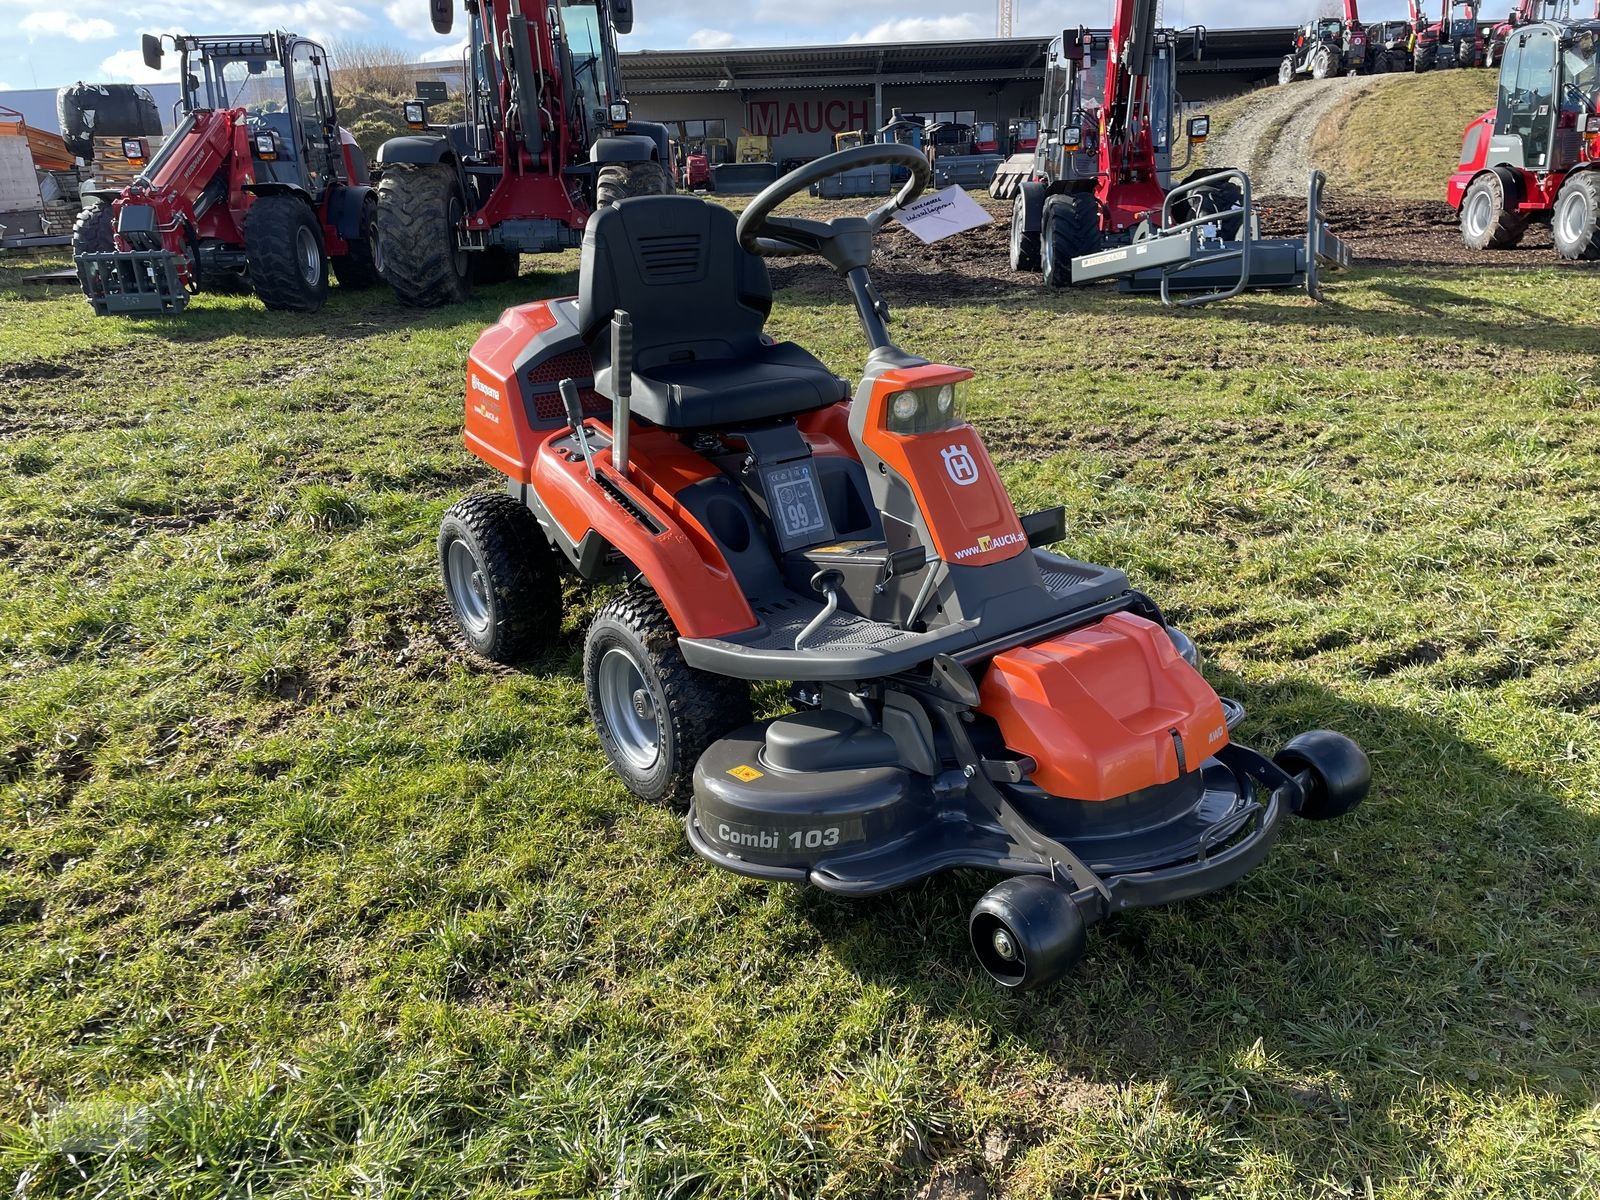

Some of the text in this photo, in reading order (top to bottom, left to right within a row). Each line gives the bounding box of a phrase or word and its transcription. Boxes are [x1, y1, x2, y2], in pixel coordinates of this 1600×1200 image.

[750, 101, 869, 136] MAUCH
[787, 502, 809, 529] 99
[1208, 725, 1223, 744] AWD
[718, 823, 840, 849] Combi 103
